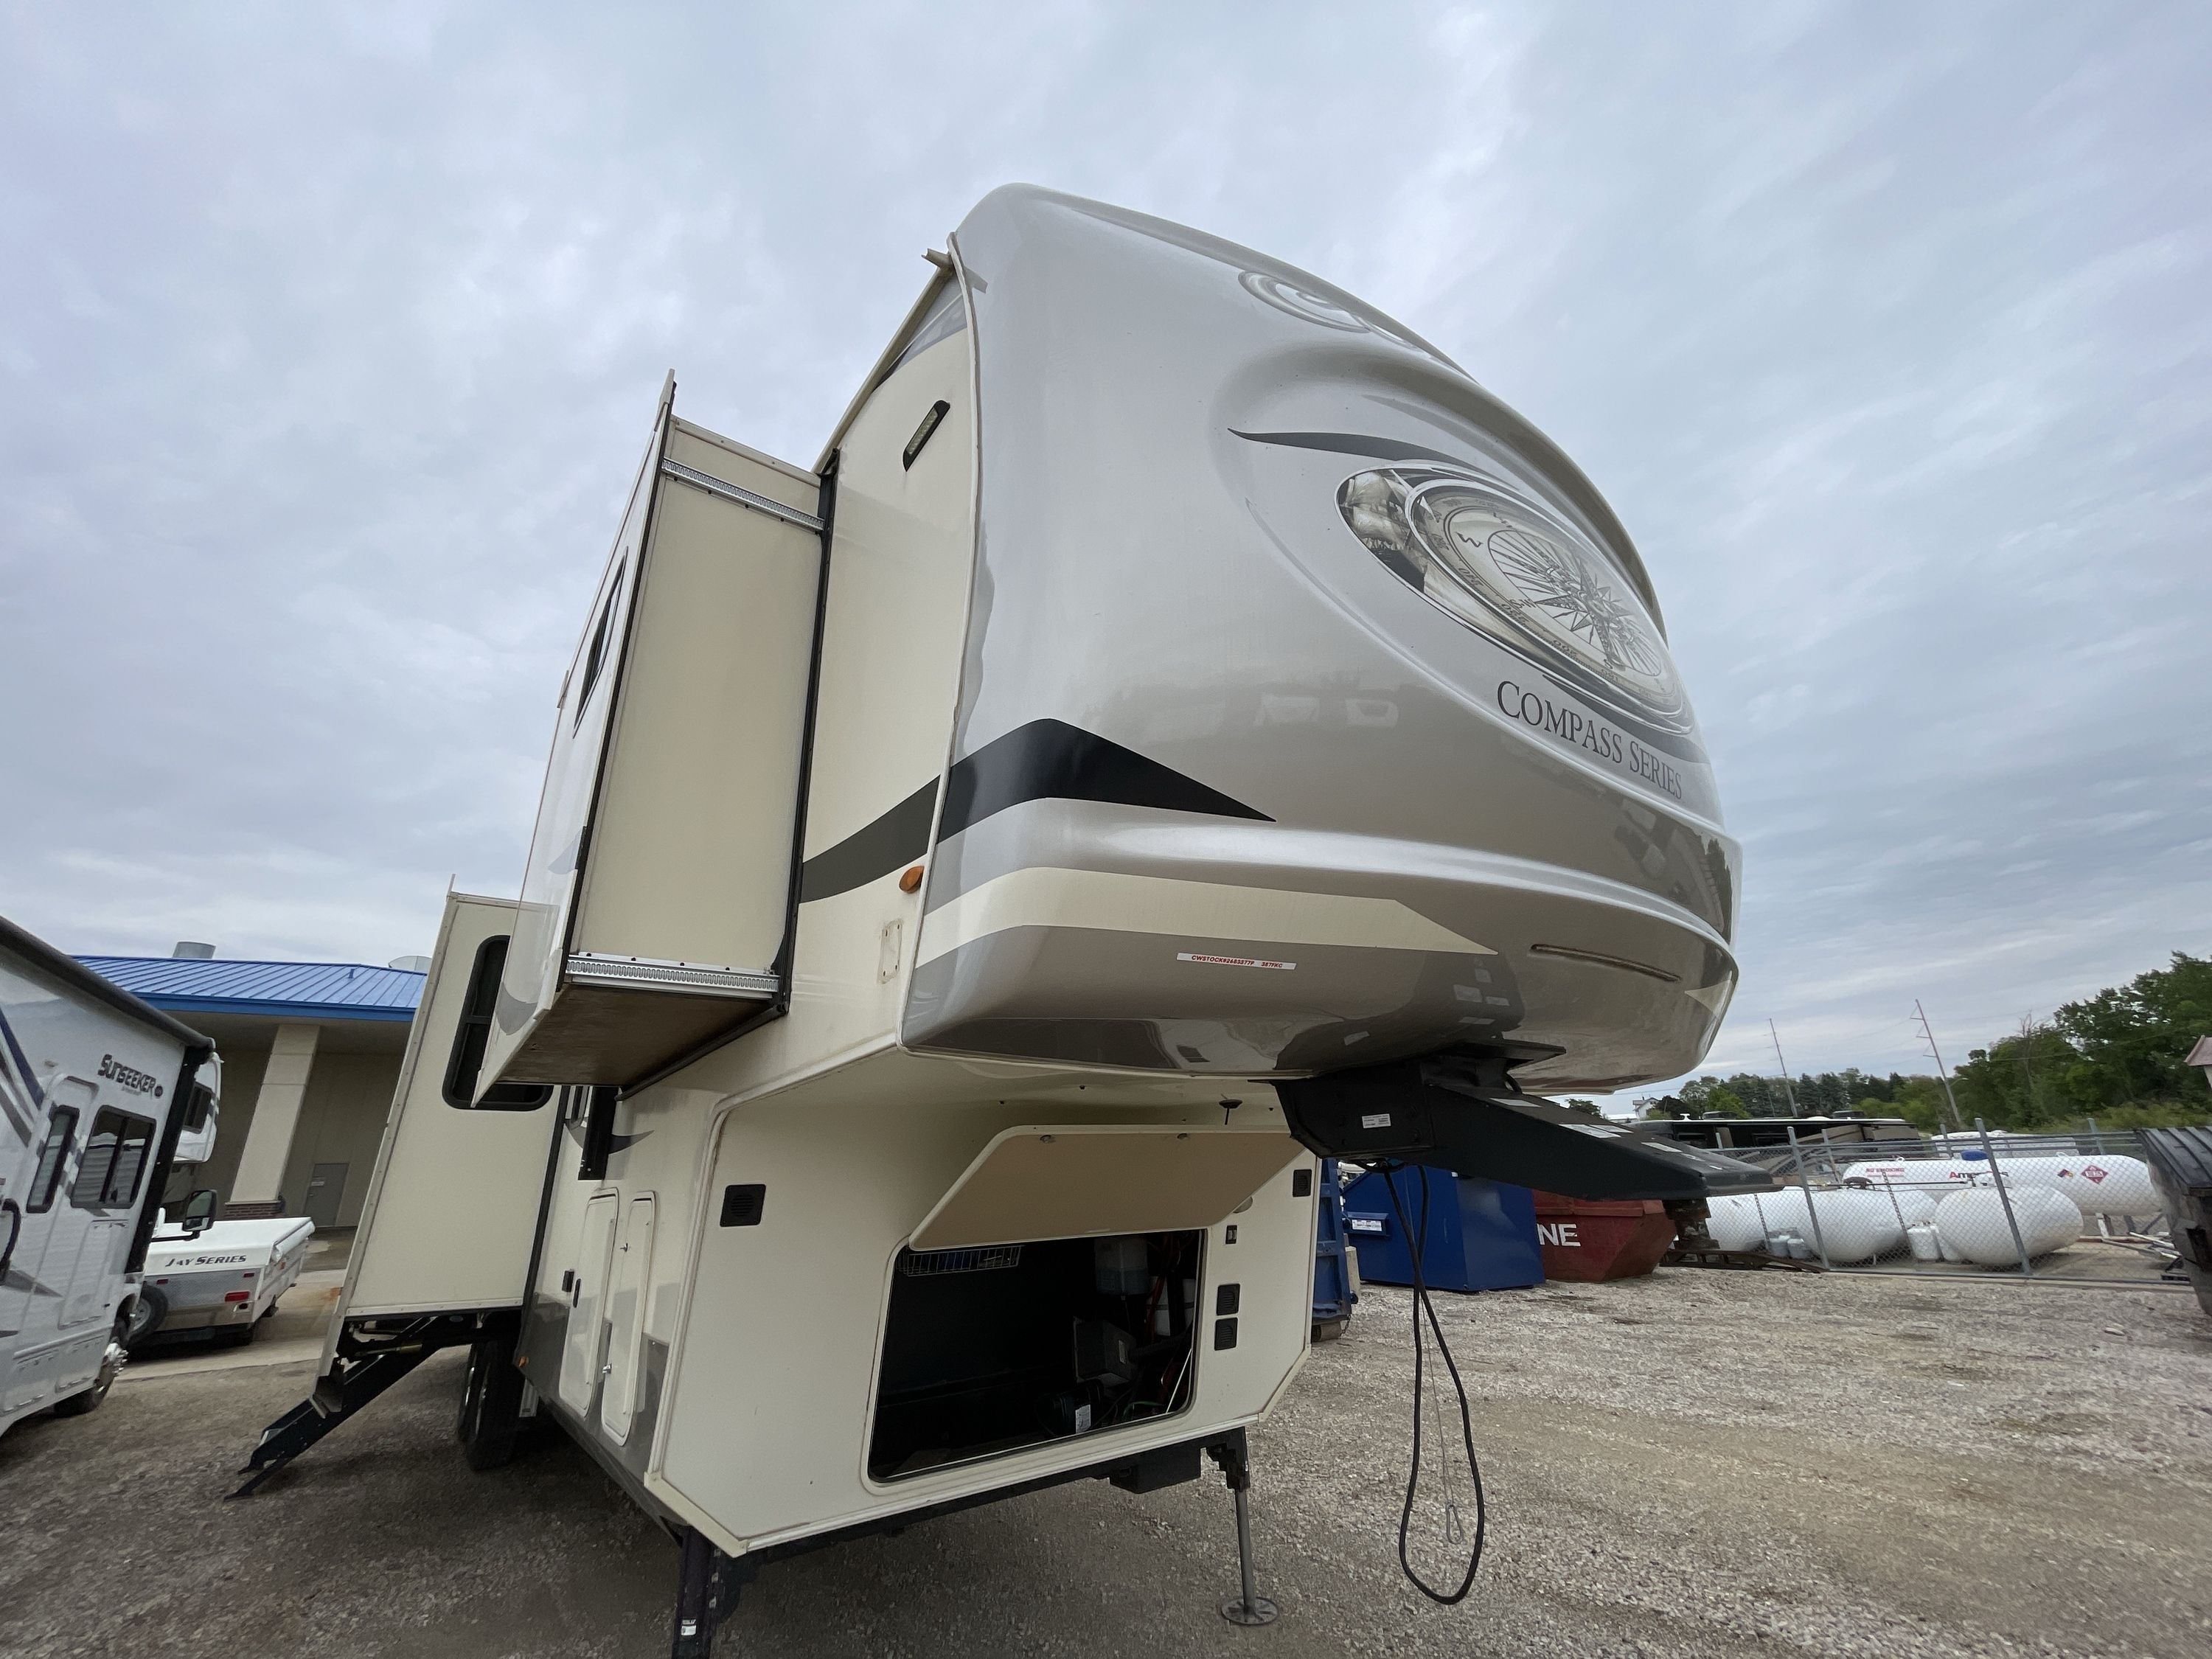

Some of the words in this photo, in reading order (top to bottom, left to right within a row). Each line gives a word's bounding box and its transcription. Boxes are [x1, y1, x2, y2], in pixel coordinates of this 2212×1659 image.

[1497, 681, 1622, 763] COMPASS
[1630, 740, 1682, 800] SERIES
[195, 1255, 246, 1265] SERIES
